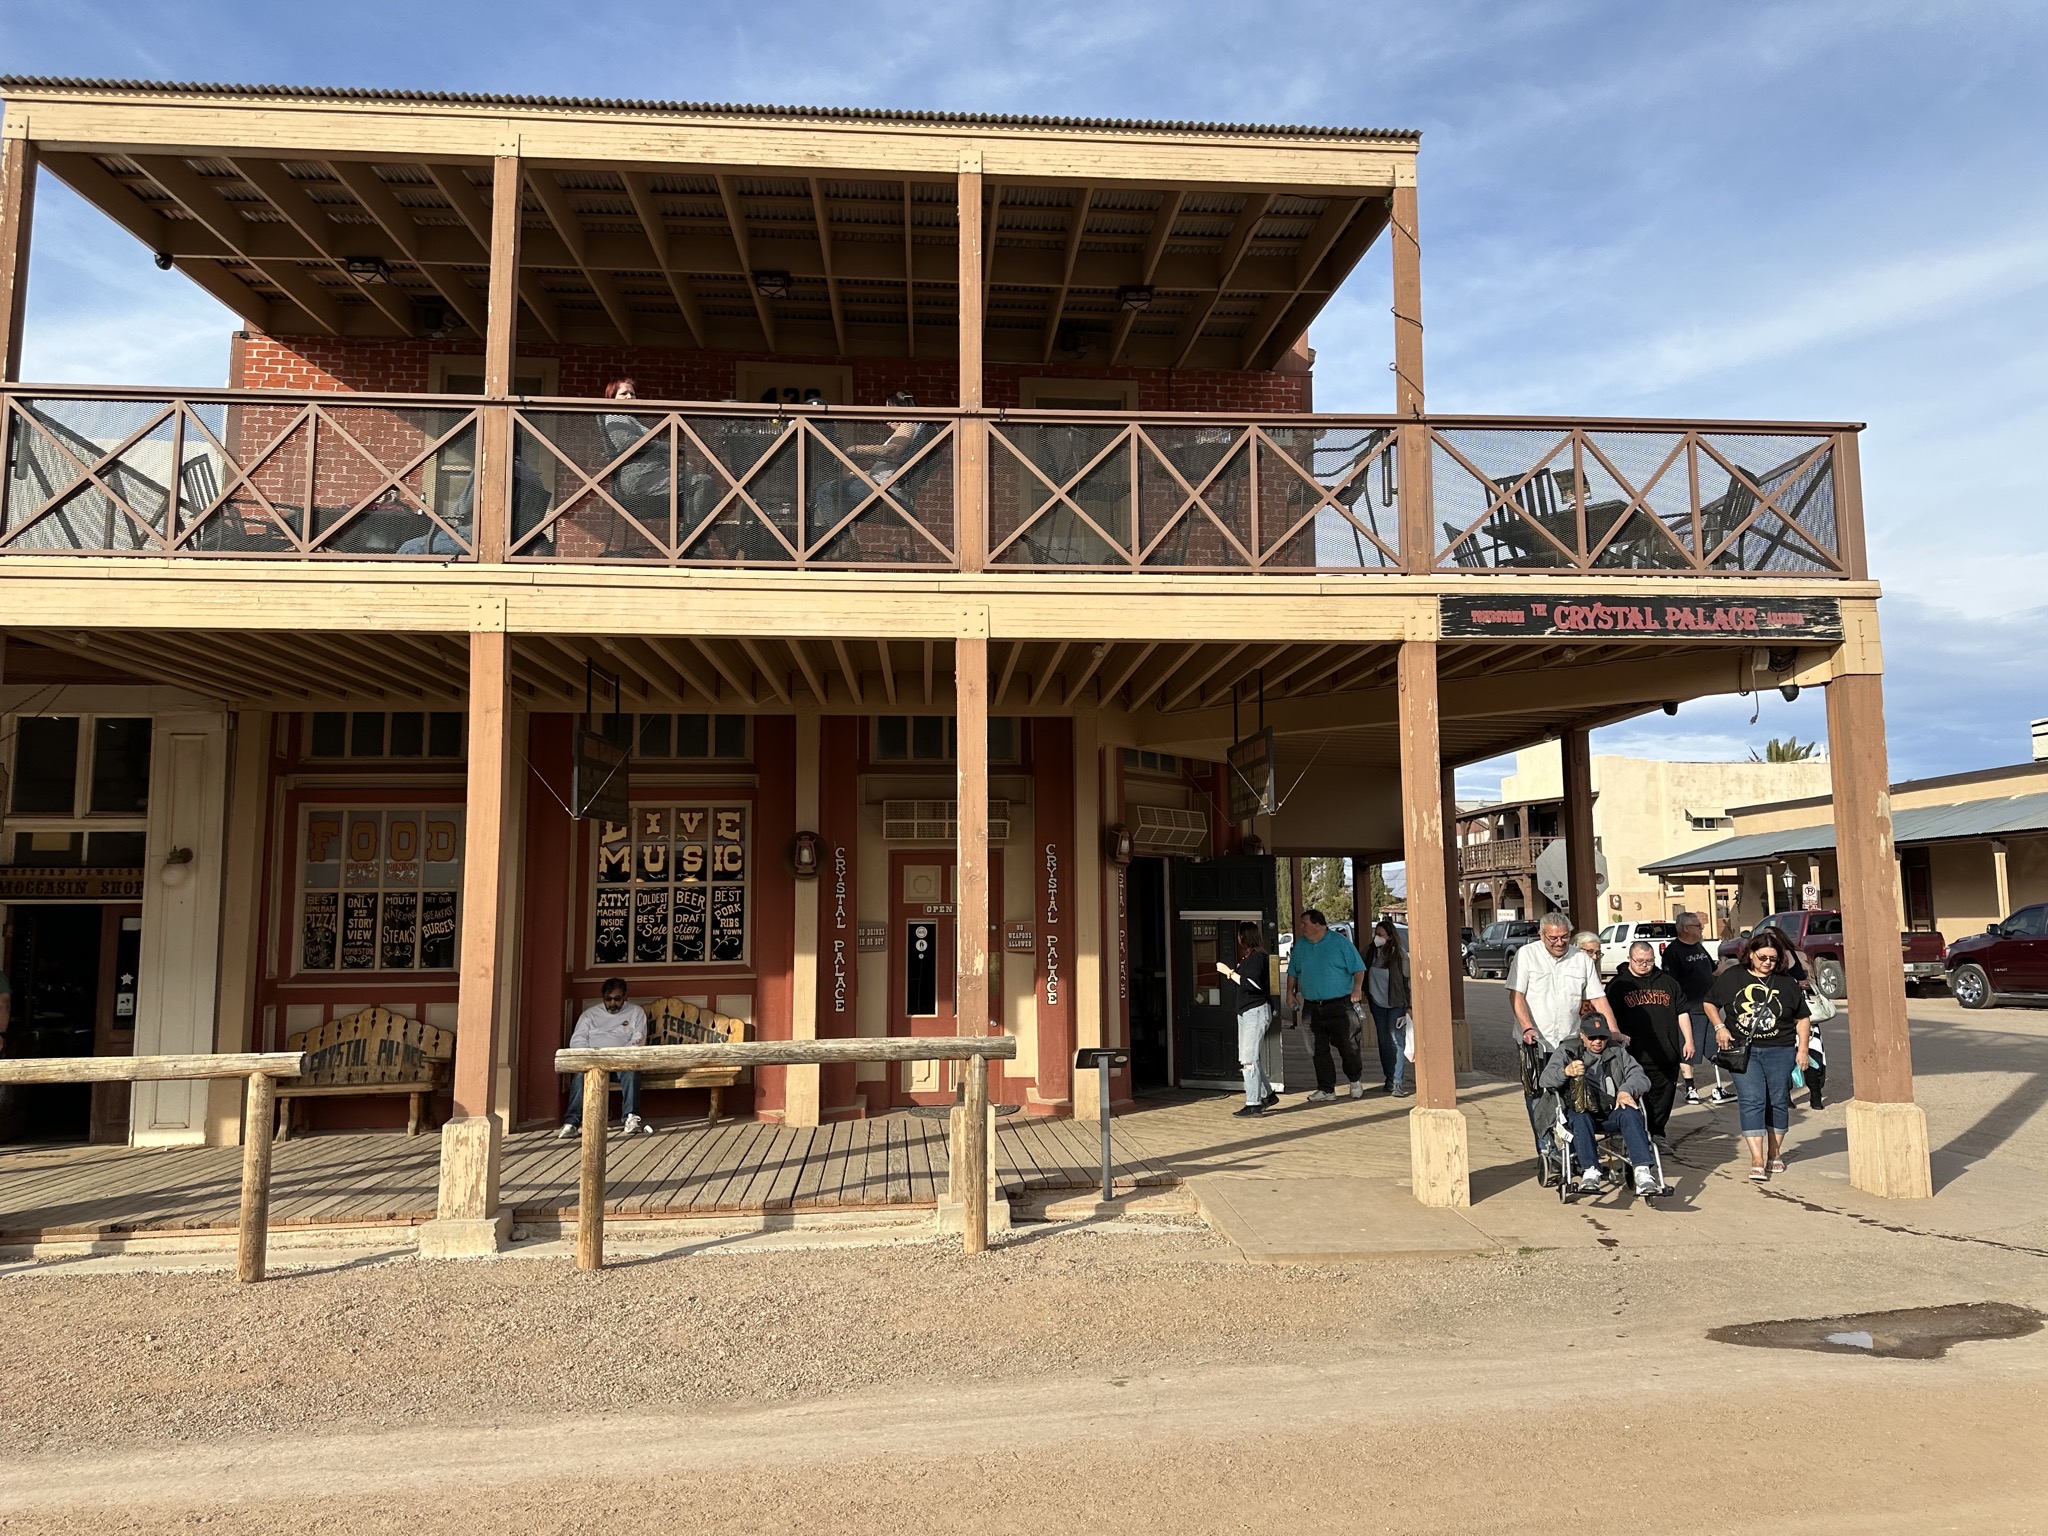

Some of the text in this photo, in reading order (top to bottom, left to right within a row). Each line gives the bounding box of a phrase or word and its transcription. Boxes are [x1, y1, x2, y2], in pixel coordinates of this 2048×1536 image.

[1531, 603, 1548, 617] THE
[1553, 602, 1660, 631] CRYSTAL
[1665, 606, 1759, 631] PALACE
[602, 811, 741, 845] LIVE
[310, 820, 457, 862] FOOD
[598, 844, 742, 874] MUSIC
[0, 869, 66, 877] WESTERN
[0, 881, 144, 896] MOCCASIN SHOP
[307, 896, 336, 905] BEST
[347, 898, 374, 908] ONLY
[386, 896, 416, 905] MOUTH
[425, 896, 452, 904] TRY OUR
[598, 893, 630, 907] ATM
[637, 890, 706, 909] COLDEST BEER
[714, 890, 742, 902] BEST
[422, 906, 455, 922] BREAKFAST
[597, 909, 628, 917] MACHINE
[714, 903, 742, 920] PORK
[926, 905, 954, 914] OPEN
[304, 913, 337, 933] PIZZA
[348, 918, 373, 929] STORY
[601, 918, 625, 927] INSIDE
[637, 913, 706, 924] BEST DRAFT
[720, 917, 740, 928] RIBS
[1045, 843, 1059, 1005] CRYSTAL PALACE
[347, 929, 372, 940] VIEW
[383, 925, 416, 944] STEAKS
[422, 919, 455, 938] BURGER
[724, 928, 742, 936] TOWN
[833, 847, 846, 1013] CRYSTAL PALACE
[343, 947, 375, 956] TOMBSTONE
[1624, 992, 1672, 1008] GIANTS
[662, 1014, 729, 1043] TERRITORY
[309, 1038, 368, 1072] CRYSTAL
